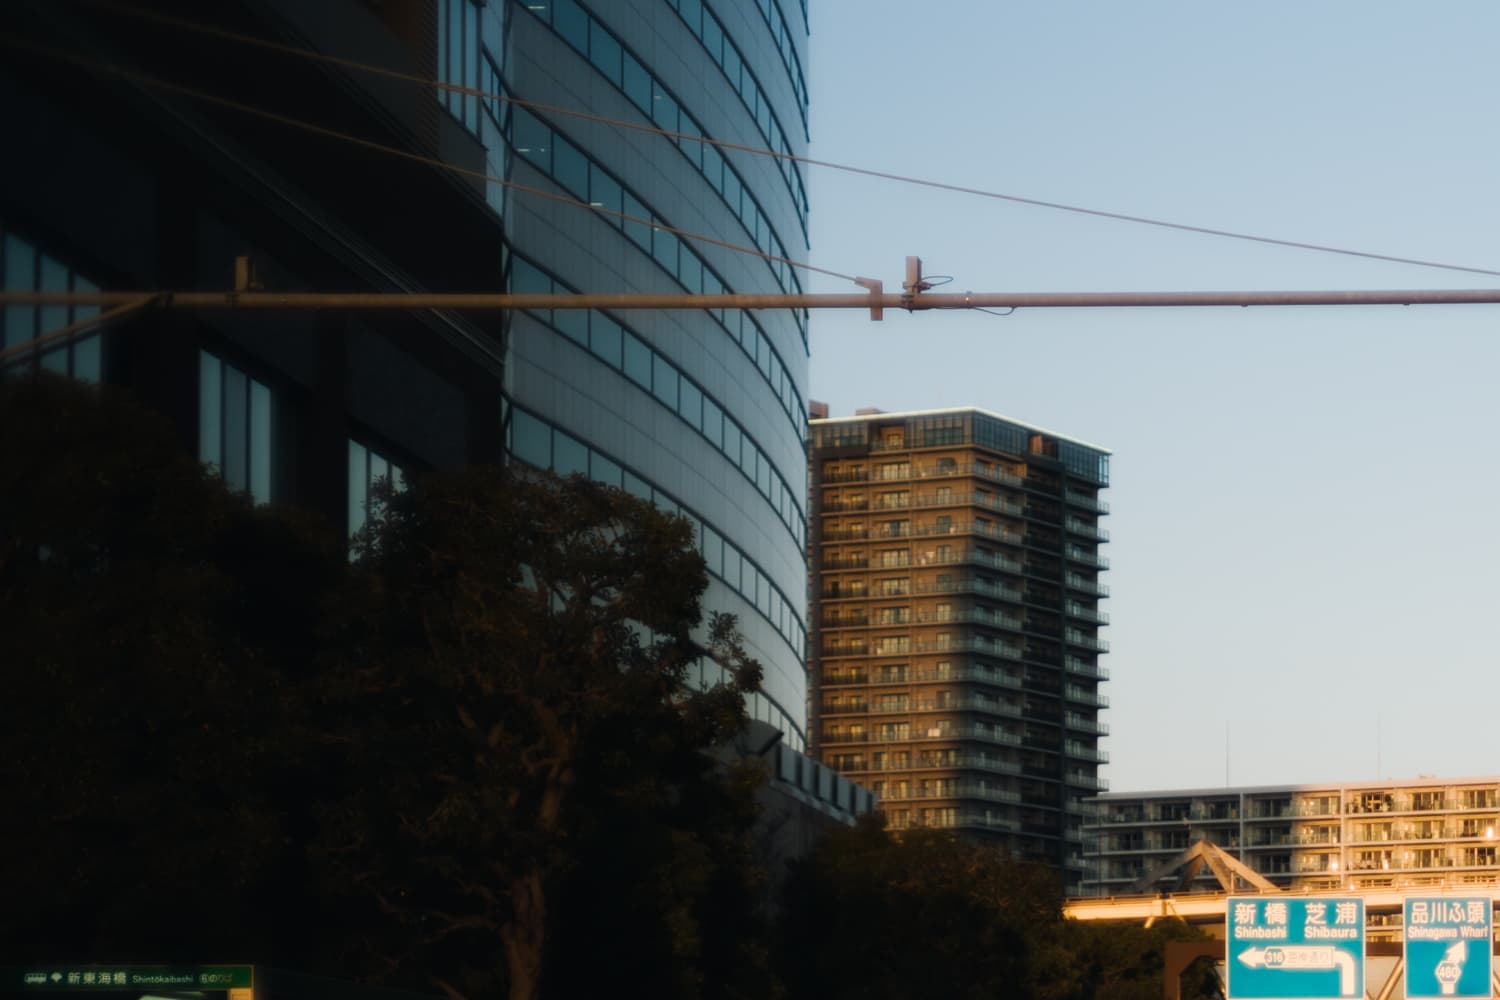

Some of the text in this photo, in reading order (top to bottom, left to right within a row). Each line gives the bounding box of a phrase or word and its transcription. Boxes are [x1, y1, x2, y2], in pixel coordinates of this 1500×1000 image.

[1234, 902, 1287, 925] 新橋
[1304, 902, 1357, 925] 芝浦
[1411, 901, 1485, 924] 品川ふ頭
[1234, 925, 1287, 939] Shinbashi
[1304, 925, 1357, 939] Shibaura
[1407, 925, 1490, 941] Shinagawa Wharf
[67, 971, 127, 985] 新東海橋
